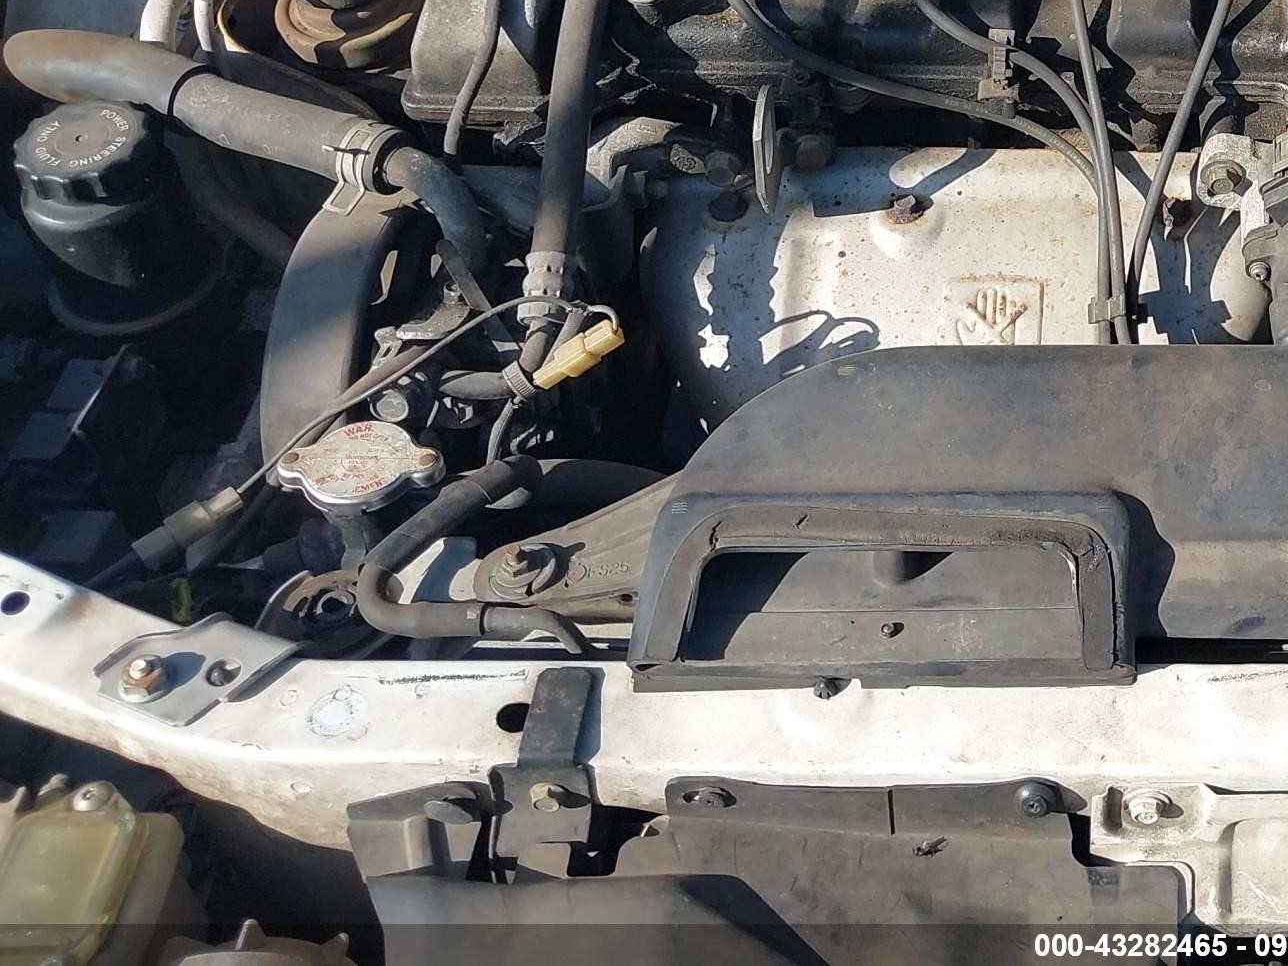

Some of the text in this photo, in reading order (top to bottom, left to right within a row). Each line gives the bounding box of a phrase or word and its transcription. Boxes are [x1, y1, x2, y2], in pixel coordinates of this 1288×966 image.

[34, 109, 129, 168] POWER STEERING FLUID ONLY
